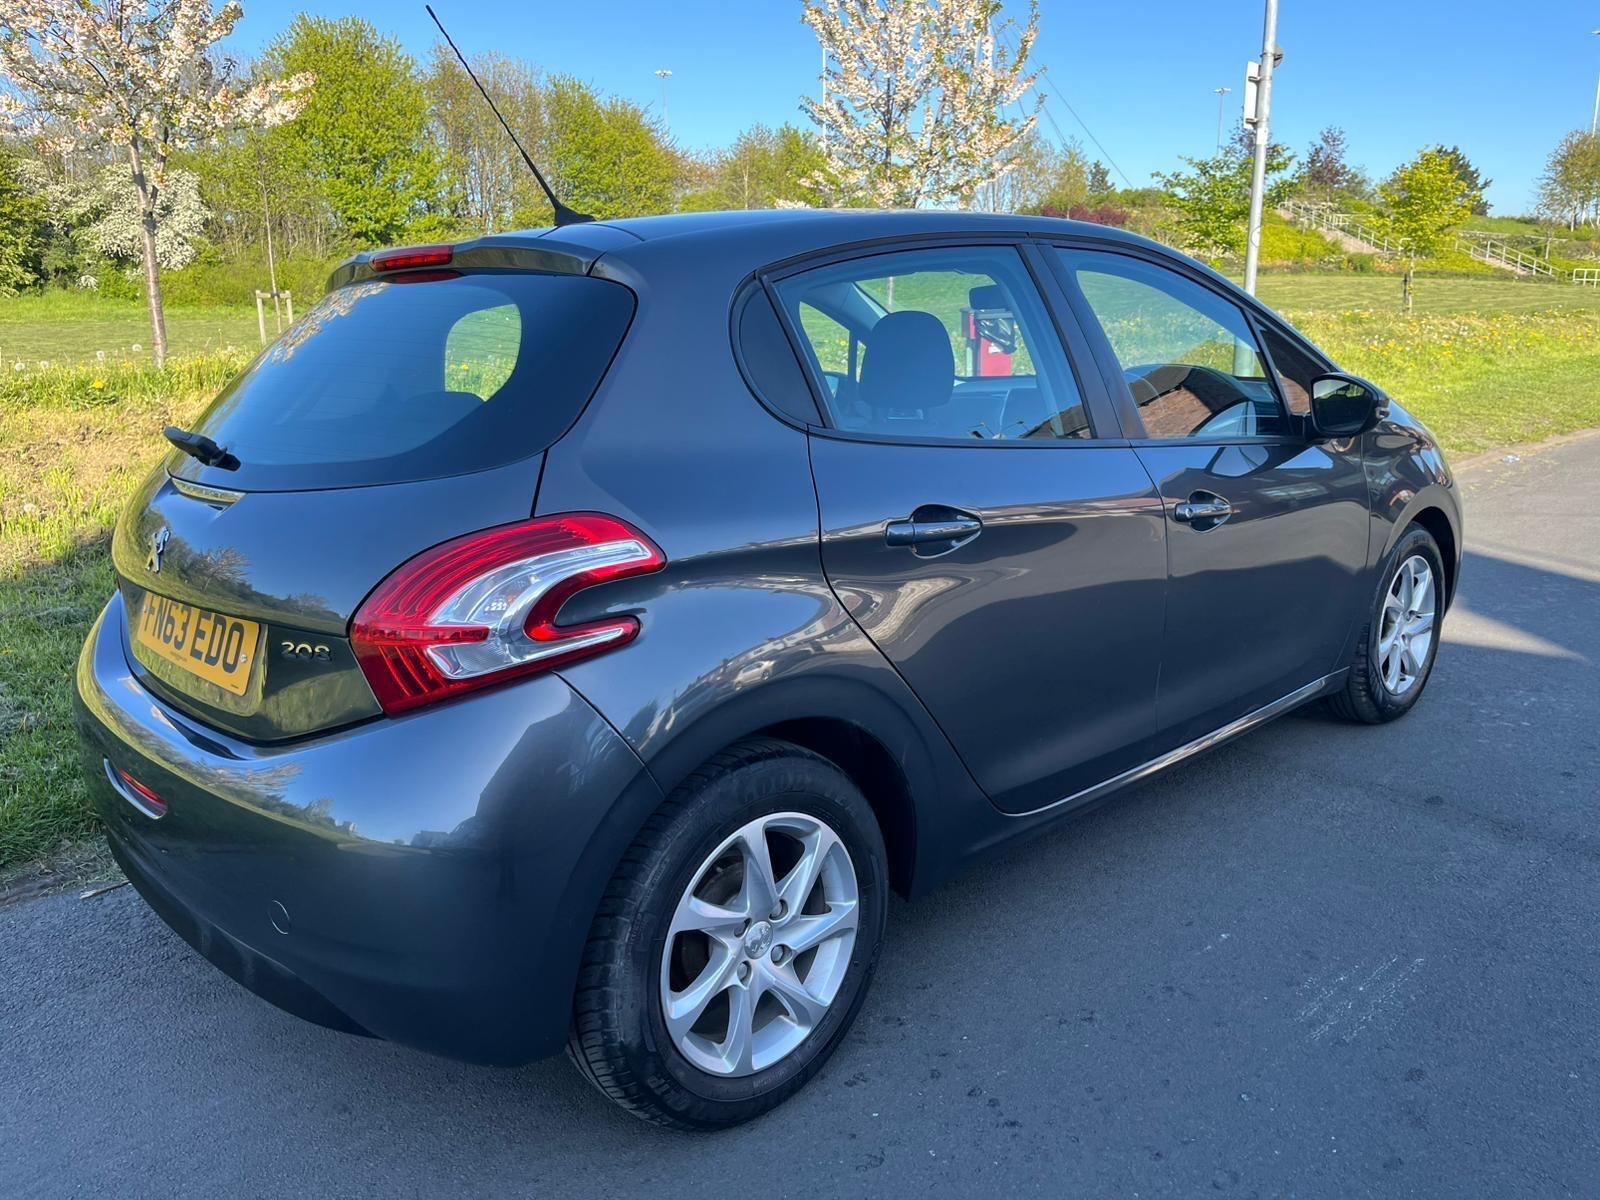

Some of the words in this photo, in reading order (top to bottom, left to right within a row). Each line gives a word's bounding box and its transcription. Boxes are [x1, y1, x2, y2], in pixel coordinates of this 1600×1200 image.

[144, 594, 192, 651] FN63
[190, 609, 245, 674] EDO
[281, 641, 332, 661] 208
